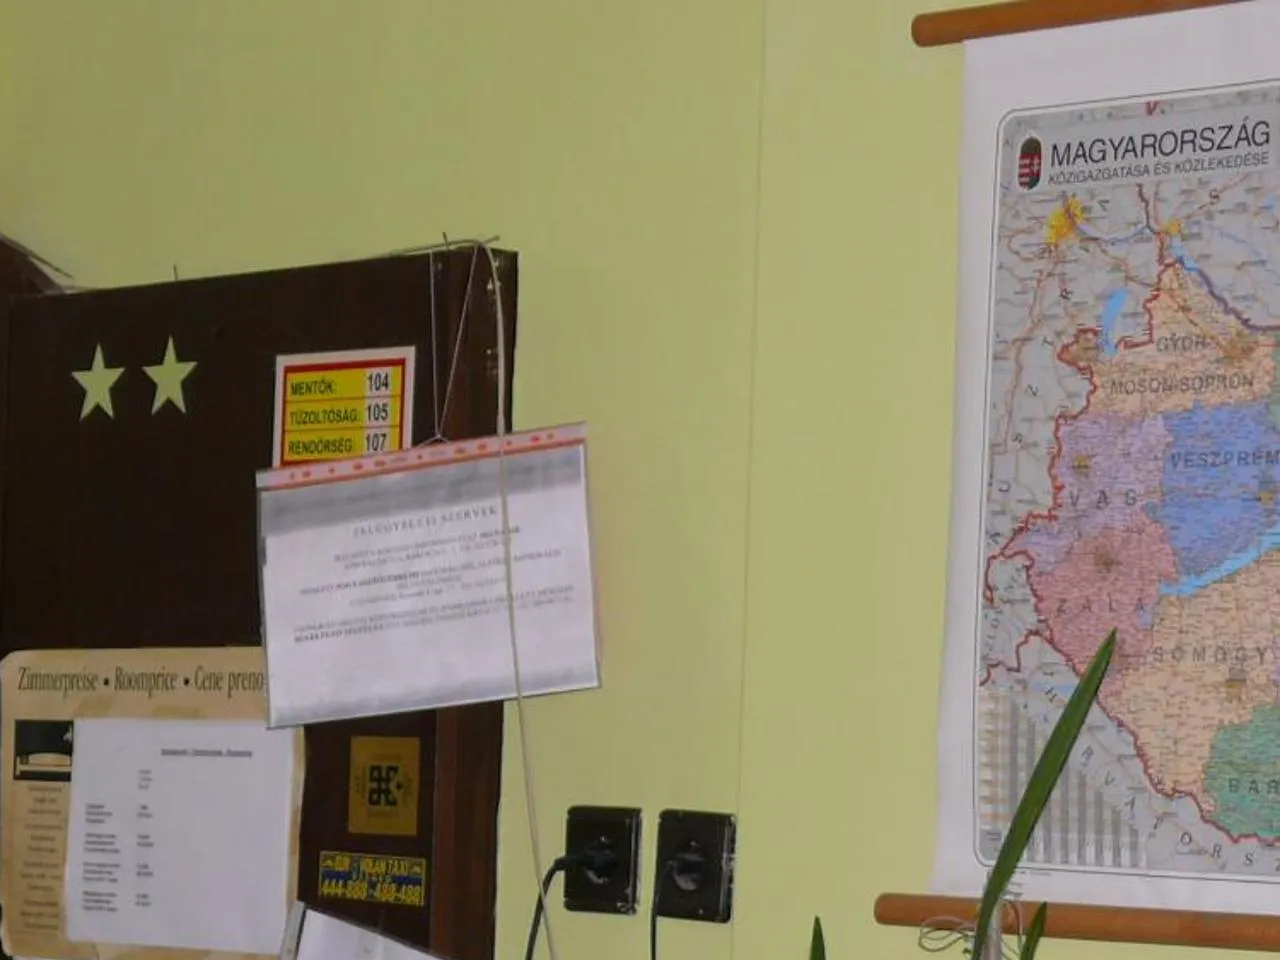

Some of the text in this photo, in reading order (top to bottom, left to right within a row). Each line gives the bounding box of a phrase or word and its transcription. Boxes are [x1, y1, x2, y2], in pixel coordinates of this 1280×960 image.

[1050, 115, 1271, 169] MAGYARORSZÁG
[1153, 160, 1171, 177] ÉS
[1174, 150, 1271, 174] KÖZLEKEDÉSE
[367, 372, 389, 392] 104
[366, 403, 389, 422] 105
[365, 433, 387, 452] 107
[18, 666, 98, 699] Zimmerpreise
[113, 666, 177, 699] Roomprice
[193, 665, 224, 692] Cene
